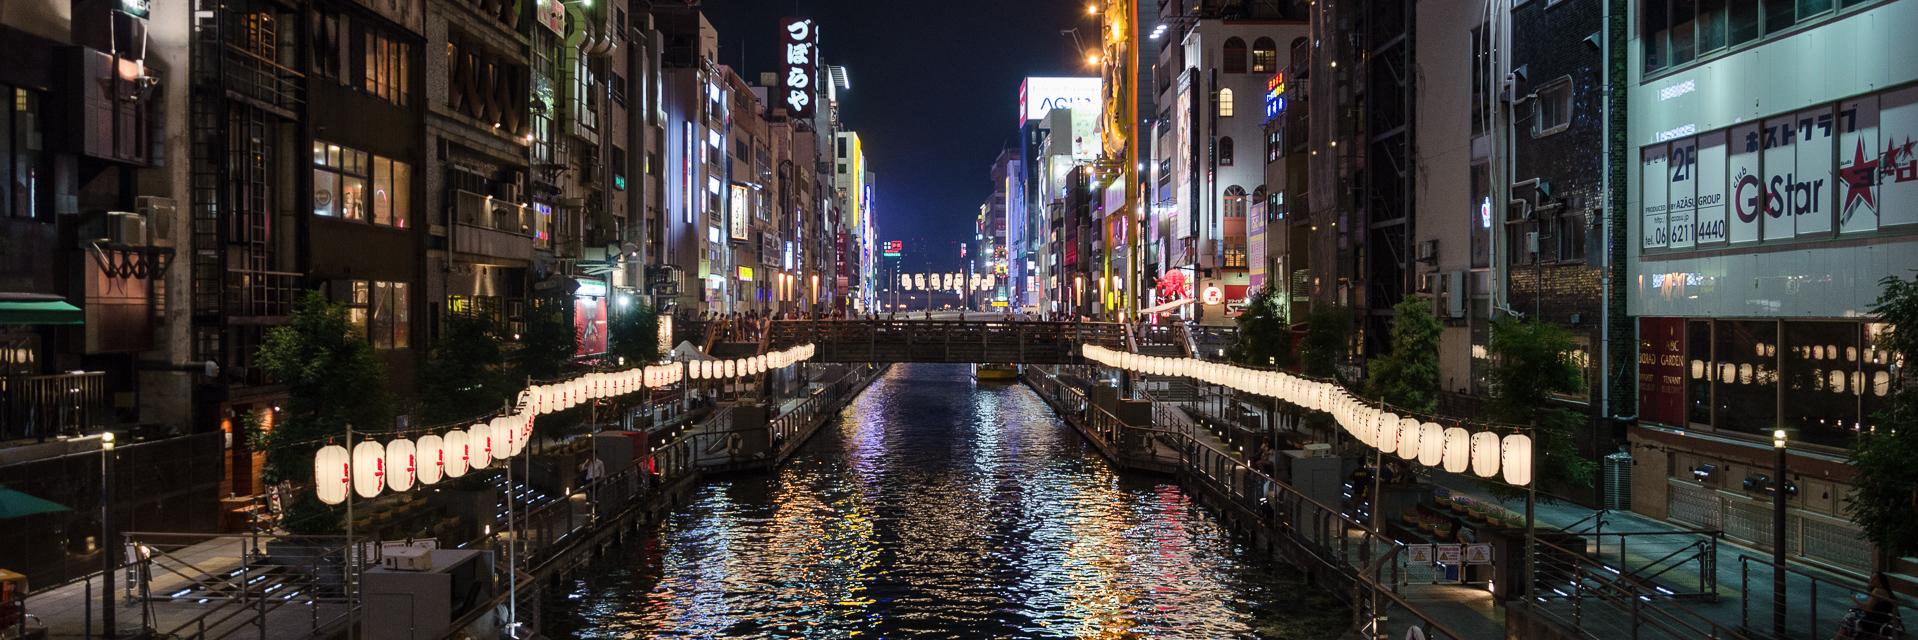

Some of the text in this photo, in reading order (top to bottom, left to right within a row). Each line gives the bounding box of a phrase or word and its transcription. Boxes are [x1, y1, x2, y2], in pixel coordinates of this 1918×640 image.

[787, 19, 812, 111] づぼらや
[1746, 104, 1858, 153] ホストクラブ
[1672, 145, 1695, 182] 2F
[1734, 166, 1747, 189] club
[1645, 205, 1666, 213] PRODUCED
[1698, 193, 1721, 206] GROUP
[1655, 227, 1667, 244] 06
[1671, 223, 1695, 243] 6211
[1698, 219, 1725, 240] 4440
[1660, 354, 1684, 367] GARDEN
